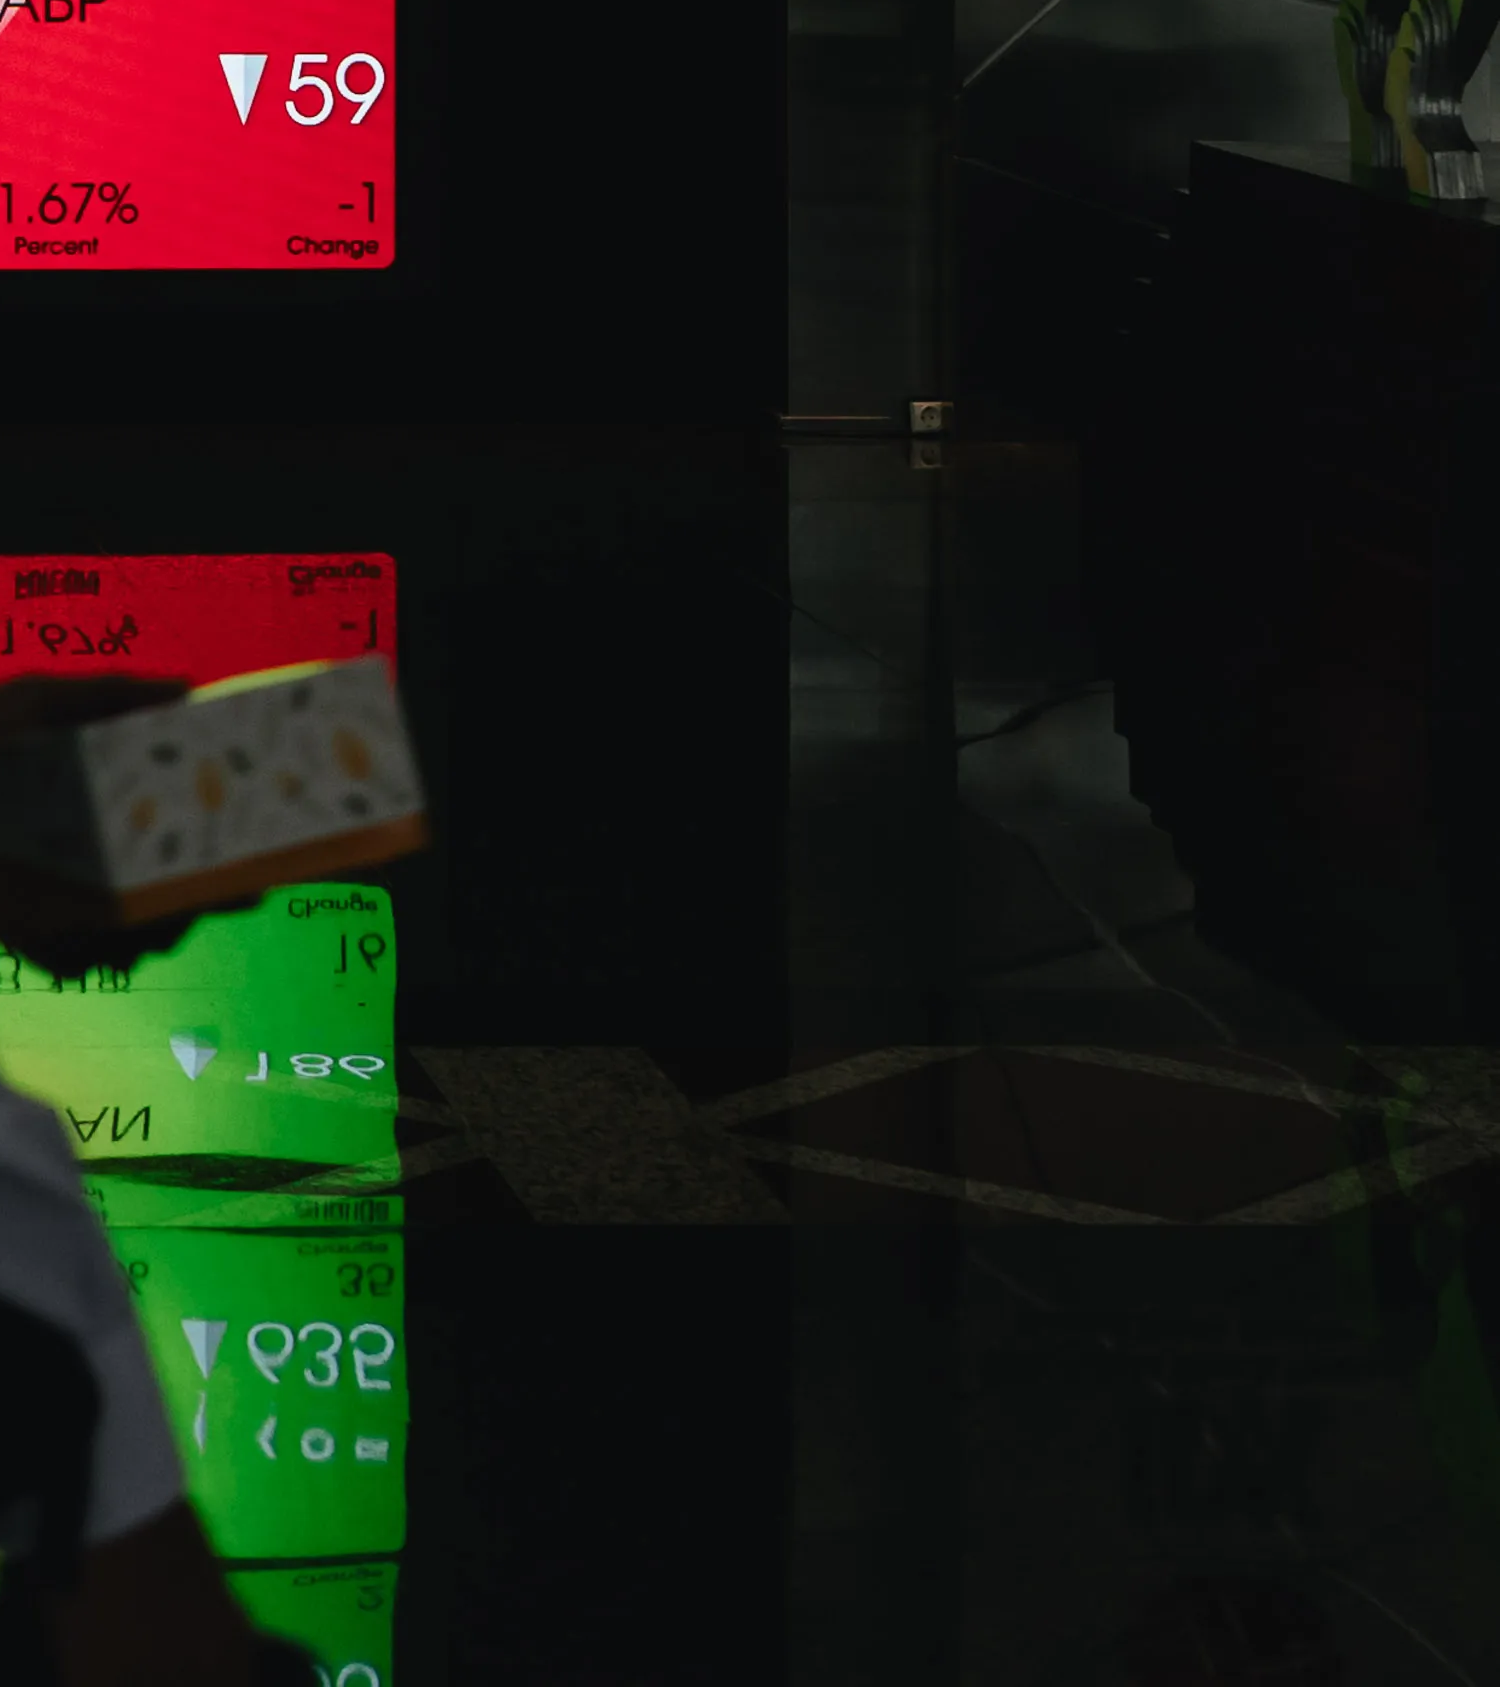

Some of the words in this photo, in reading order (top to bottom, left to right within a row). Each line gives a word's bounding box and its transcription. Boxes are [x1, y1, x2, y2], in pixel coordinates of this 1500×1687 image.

[285, 52, 386, 126] 59
[339, 182, 374, 223] -1
[15, 236, 98, 255] Percent
[287, 236, 379, 260] Change
